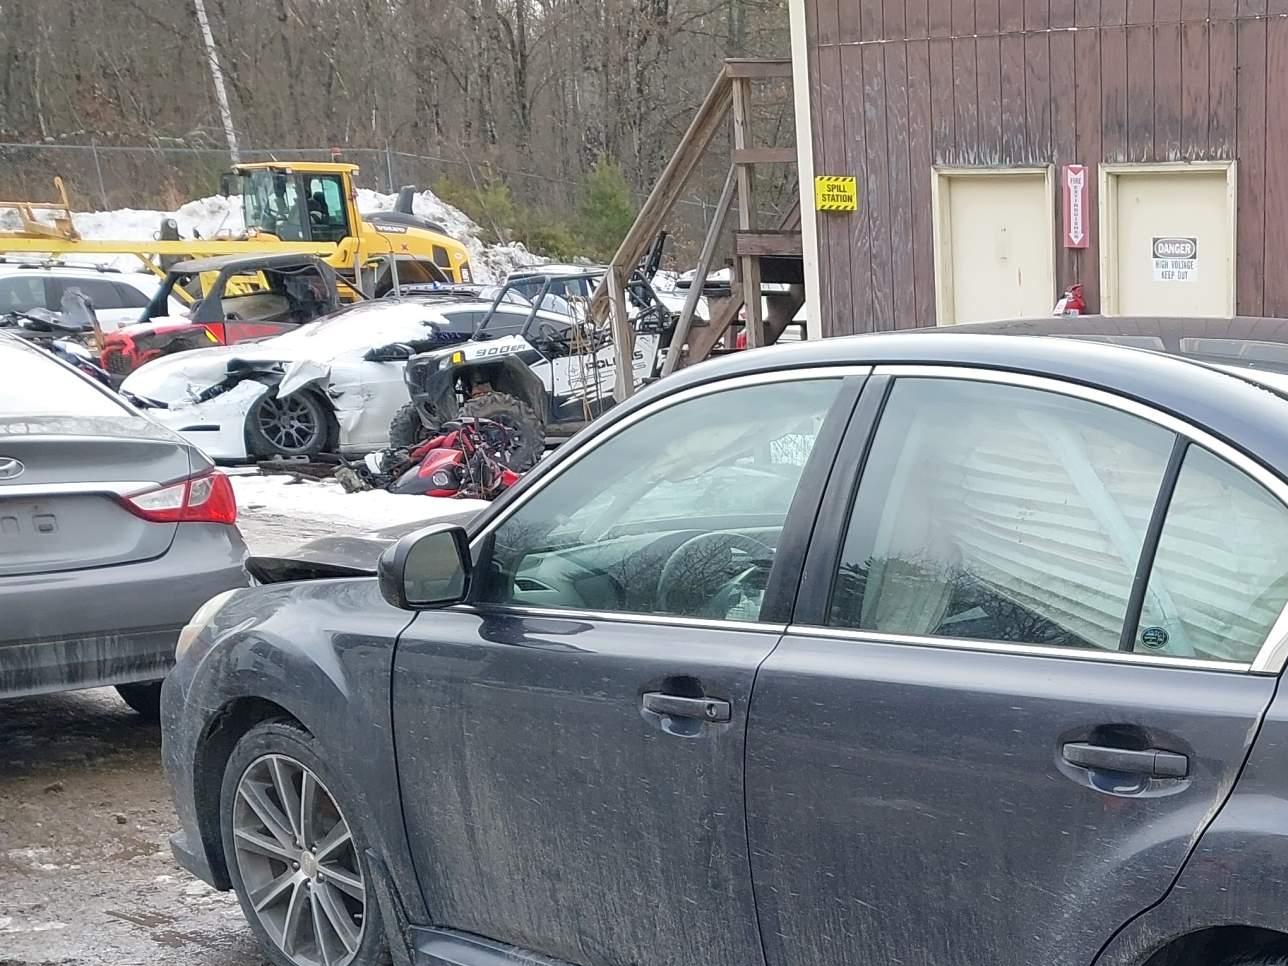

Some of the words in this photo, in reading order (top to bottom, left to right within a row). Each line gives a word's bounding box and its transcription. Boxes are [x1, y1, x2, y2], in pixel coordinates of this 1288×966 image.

[826, 184, 847, 193] SPILL
[821, 193, 853, 203] STATION
[1158, 243, 1191, 254] DANGER
[1171, 260, 1194, 270] VOLTAGE
